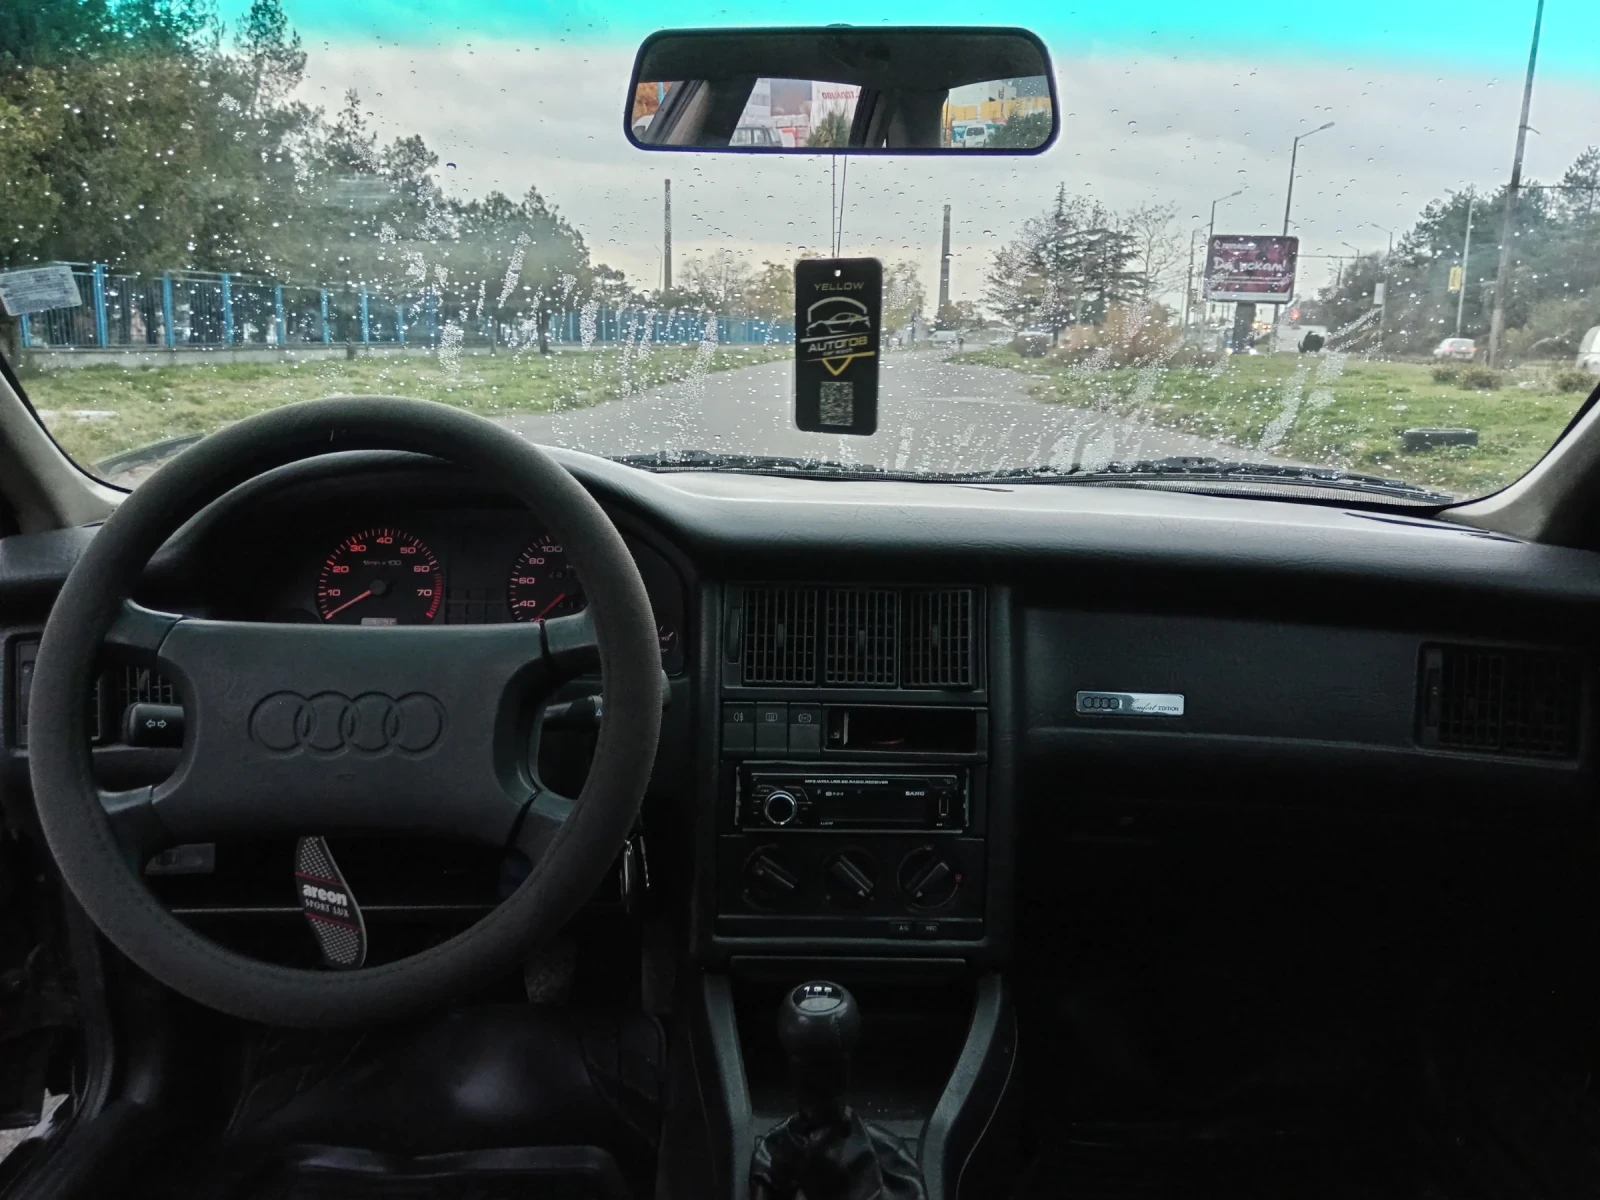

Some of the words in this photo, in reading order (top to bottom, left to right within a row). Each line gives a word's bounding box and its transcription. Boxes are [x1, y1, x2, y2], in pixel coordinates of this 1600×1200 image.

[814, 282, 865, 291] YELLOW
[541, 545, 563, 553] 100
[528, 557, 545, 565] 80
[332, 565, 349, 573] 20
[413, 565, 430, 573] 60
[518, 577, 535, 585] 60
[302, 884, 348, 906] areon
